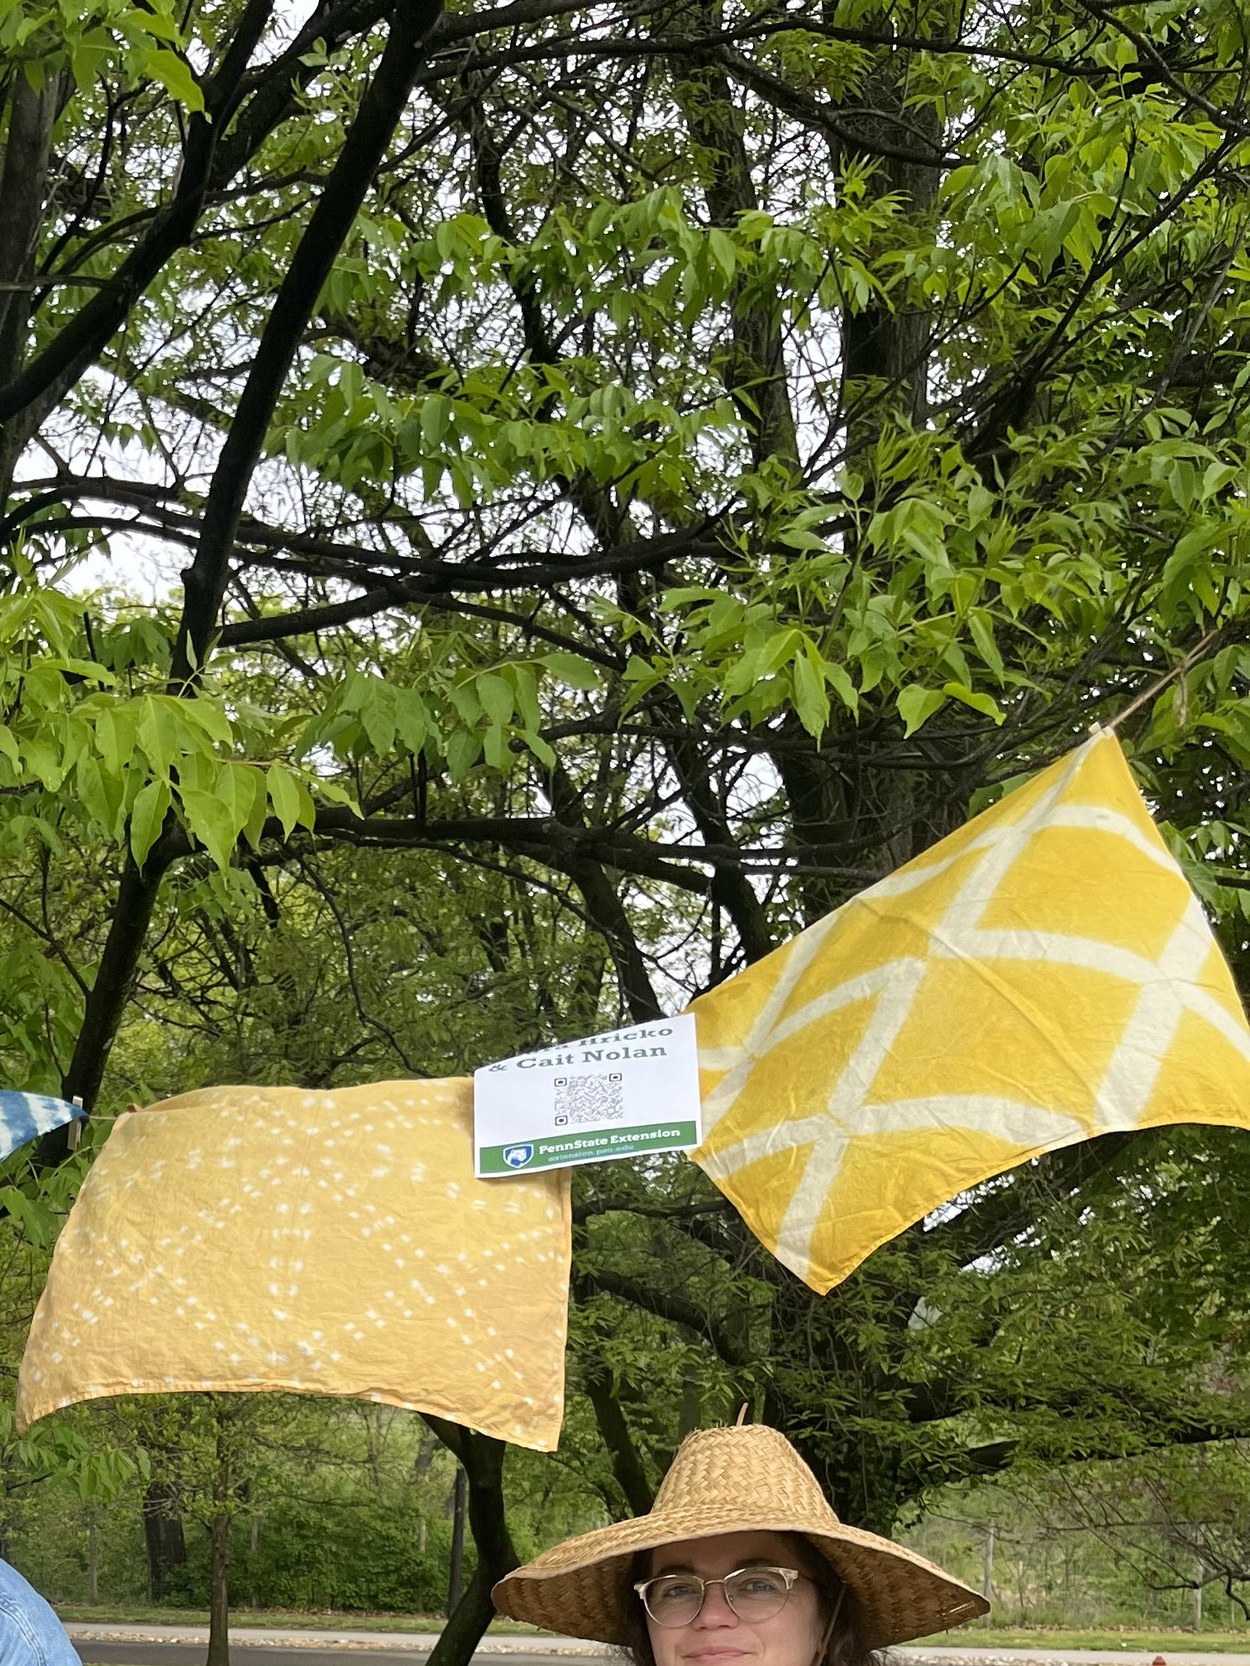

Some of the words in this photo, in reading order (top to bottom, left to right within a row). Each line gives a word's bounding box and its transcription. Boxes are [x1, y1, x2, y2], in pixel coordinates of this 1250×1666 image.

[516, 1054, 575, 1070] Cait
[582, 1045, 667, 1063] Nolan
[539, 1138, 608, 1155] PennState
[610, 1129, 681, 1144] Extension
